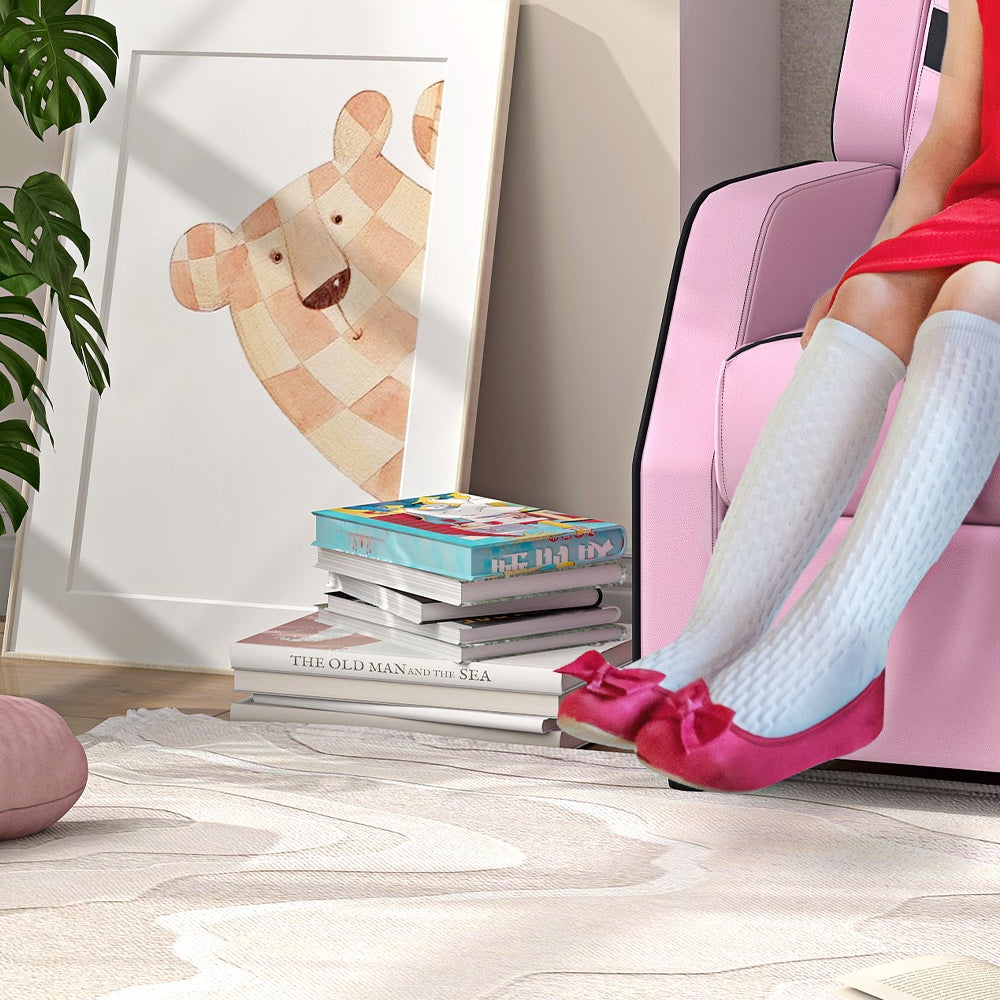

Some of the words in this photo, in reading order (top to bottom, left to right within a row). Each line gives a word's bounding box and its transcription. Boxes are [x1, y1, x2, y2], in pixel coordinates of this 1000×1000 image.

[290, 654, 325, 669] THE
[328, 657, 364, 672] OLD
[369, 661, 406, 675] MAN
[407, 668, 431, 677] AND
[433, 669, 456, 679] THE
[459, 668, 491, 683] SEA
